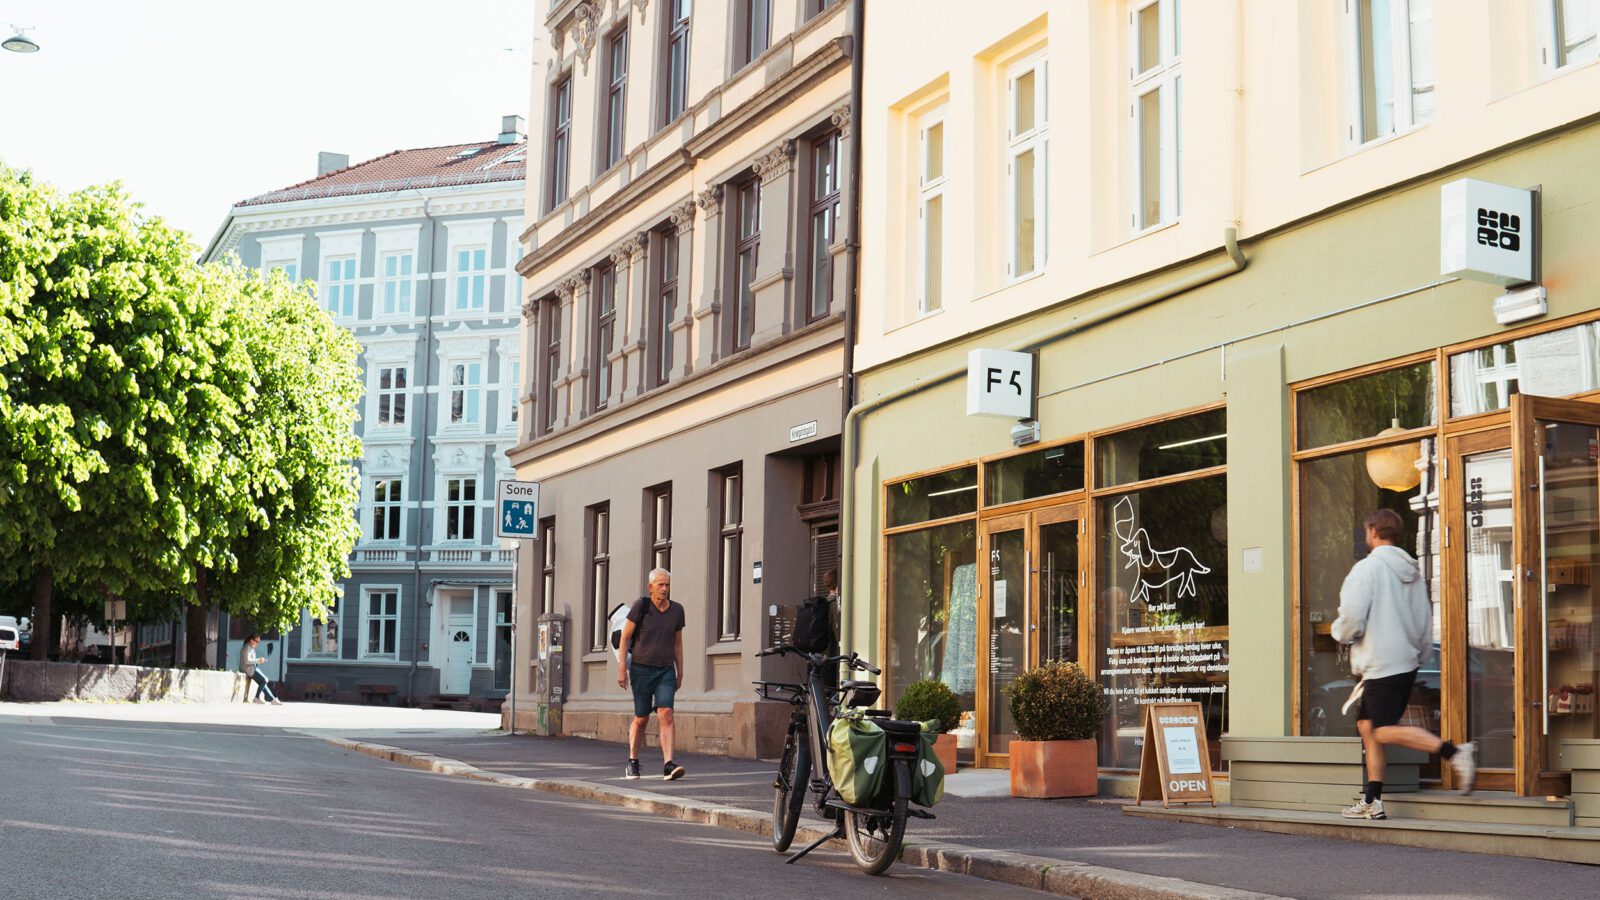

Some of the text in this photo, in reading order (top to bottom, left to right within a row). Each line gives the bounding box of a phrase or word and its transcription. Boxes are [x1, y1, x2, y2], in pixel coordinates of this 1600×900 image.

[987, 367, 1022, 396] F5
[506, 484, 533, 496] Sone
[1148, 604, 1156, 612] Bar
[1156, 602, 1163, 613] på
[1201, 642, 1212, 650] hver
[1127, 656, 1133, 665] på
[1133, 656, 1156, 665] Instagram
[1213, 651, 1221, 662] på
[1200, 665, 1207, 673] og
[1169, 779, 1207, 792] OPEN
